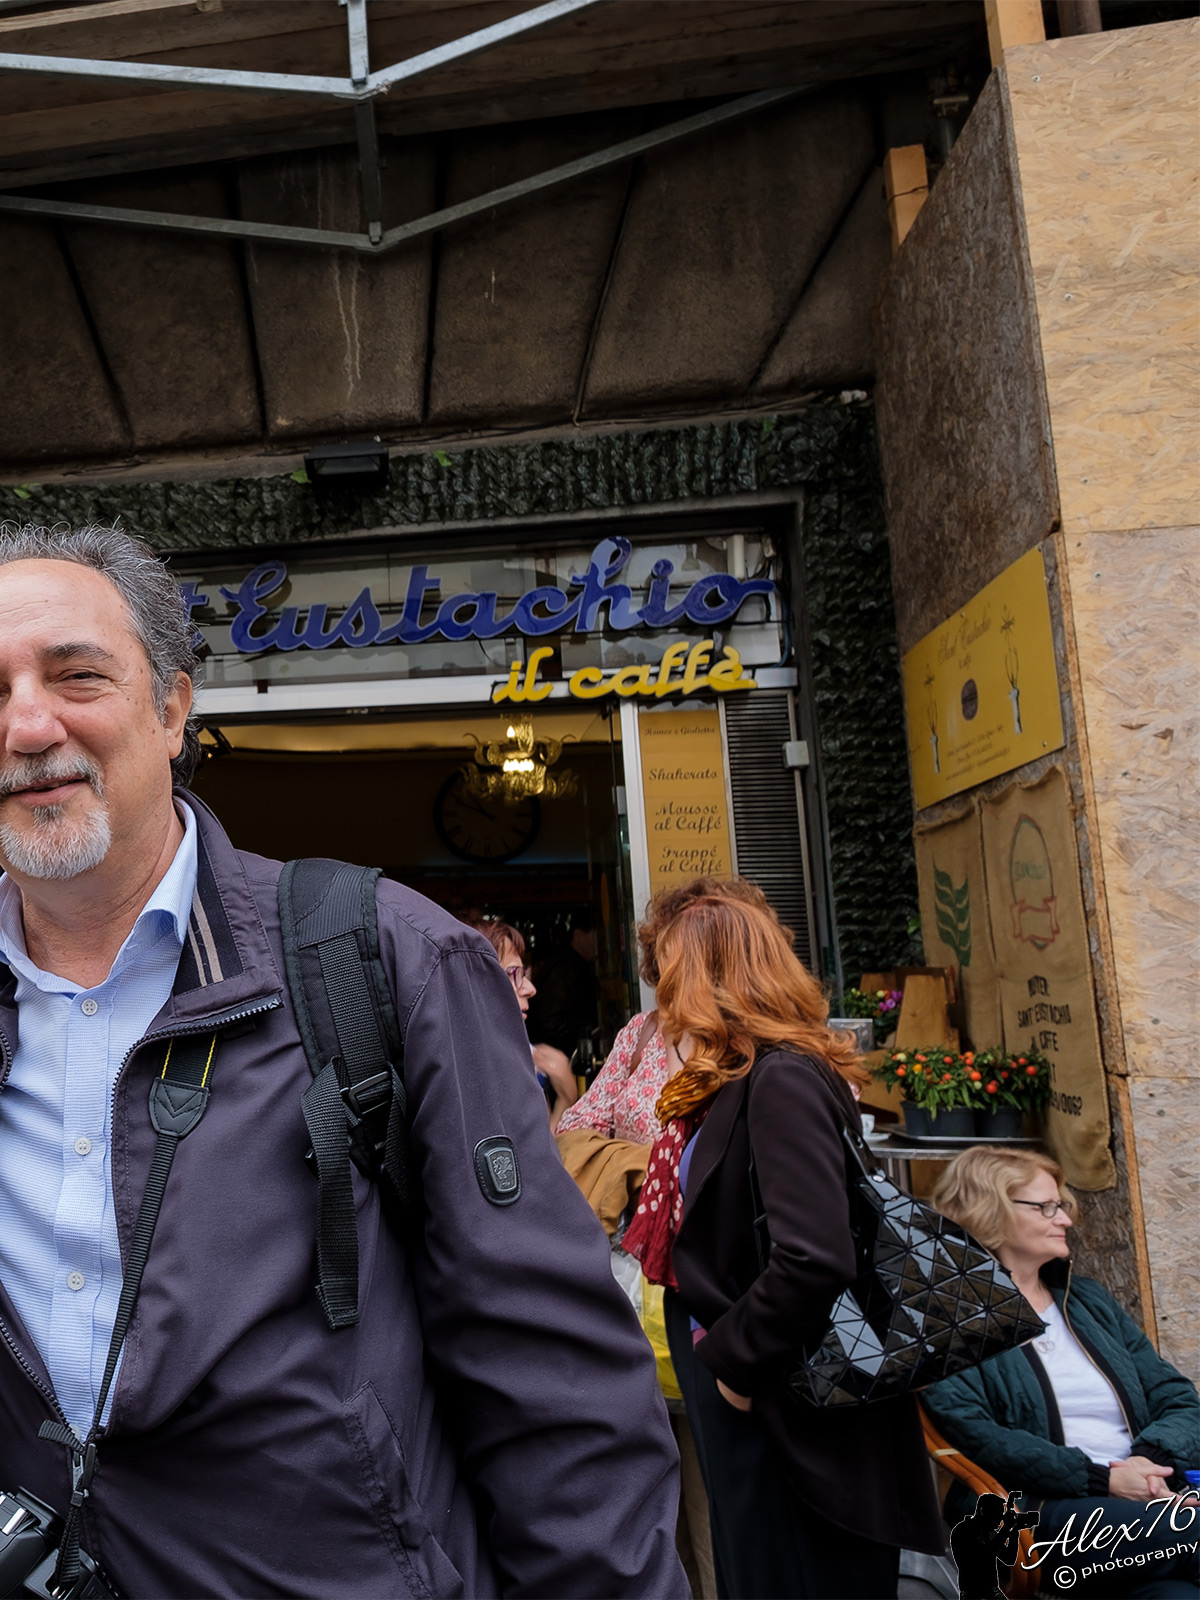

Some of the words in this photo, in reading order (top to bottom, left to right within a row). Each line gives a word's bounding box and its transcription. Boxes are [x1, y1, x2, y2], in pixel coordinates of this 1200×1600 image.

[219, 535, 776, 654] Eustachio
[492, 646, 554, 704] il
[648, 767, 717, 781] Shakerato
[655, 801, 719, 816] Mousse
[654, 816, 672, 831] al
[658, 859, 675, 873] al
